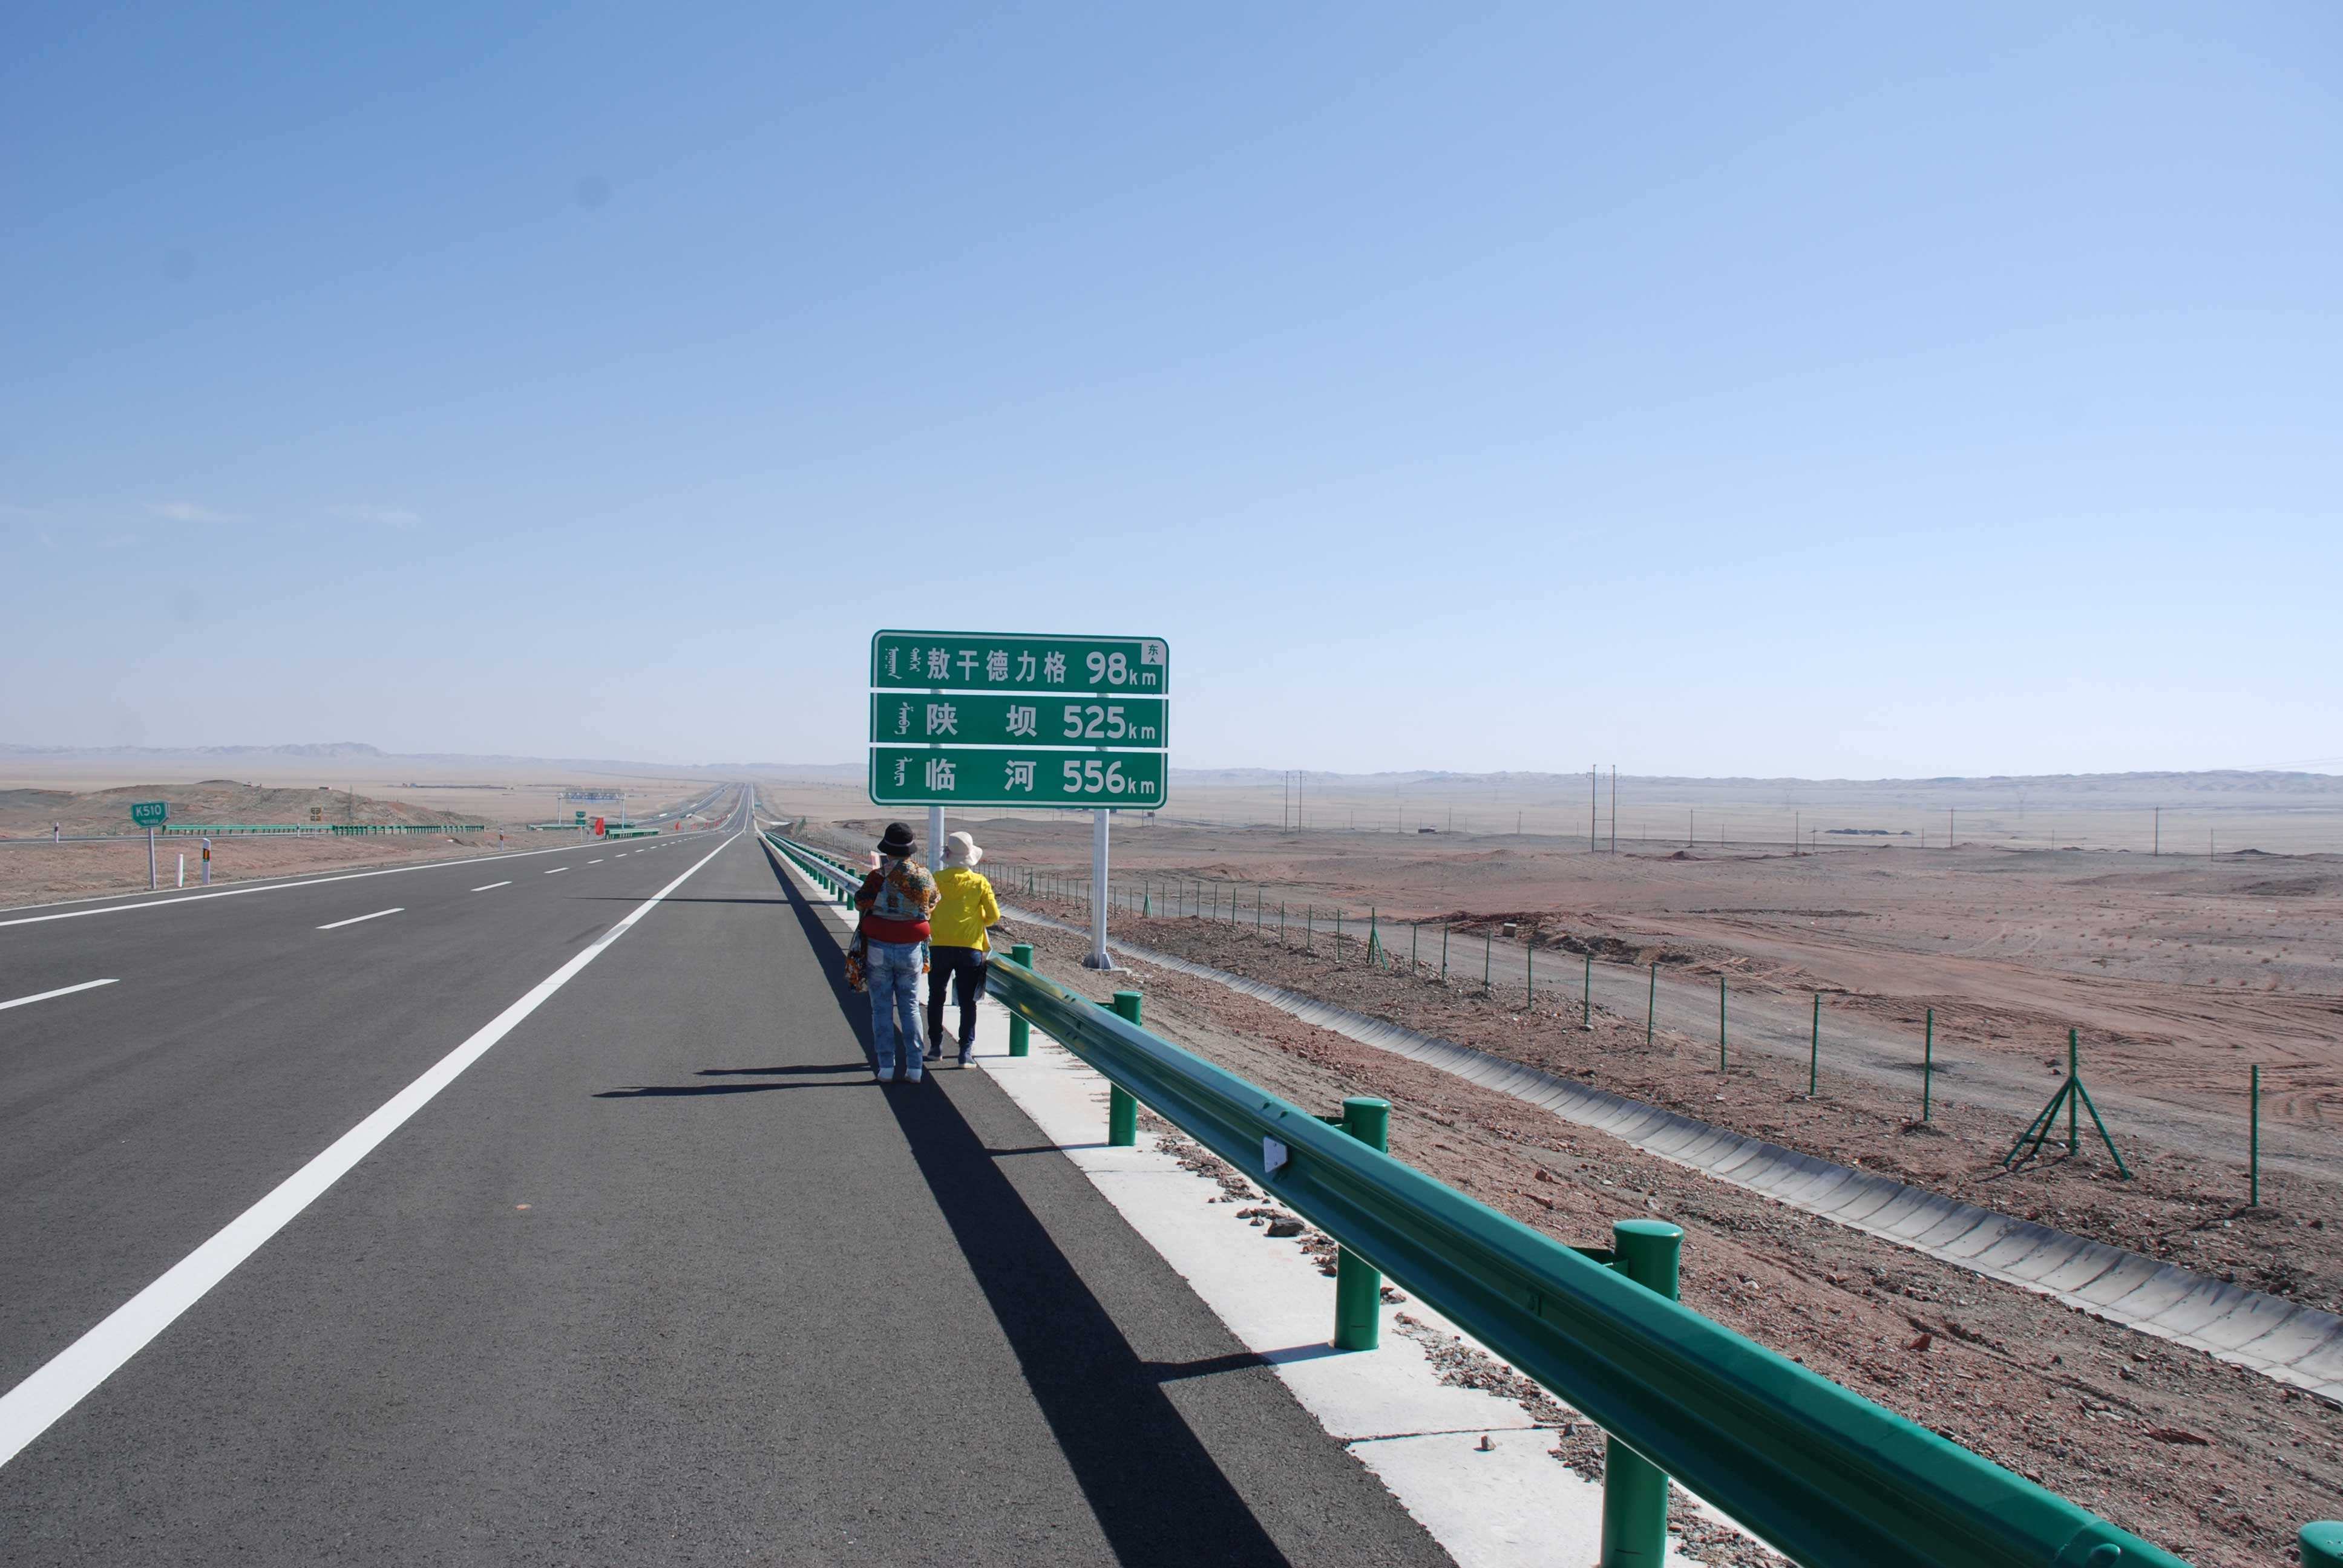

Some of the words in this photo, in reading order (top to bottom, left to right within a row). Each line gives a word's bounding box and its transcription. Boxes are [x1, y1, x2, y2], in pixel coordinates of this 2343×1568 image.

[1148, 644, 1158, 656] 东
[927, 647, 1067, 683] 敖干德力格
[136, 805, 162, 817] K510
